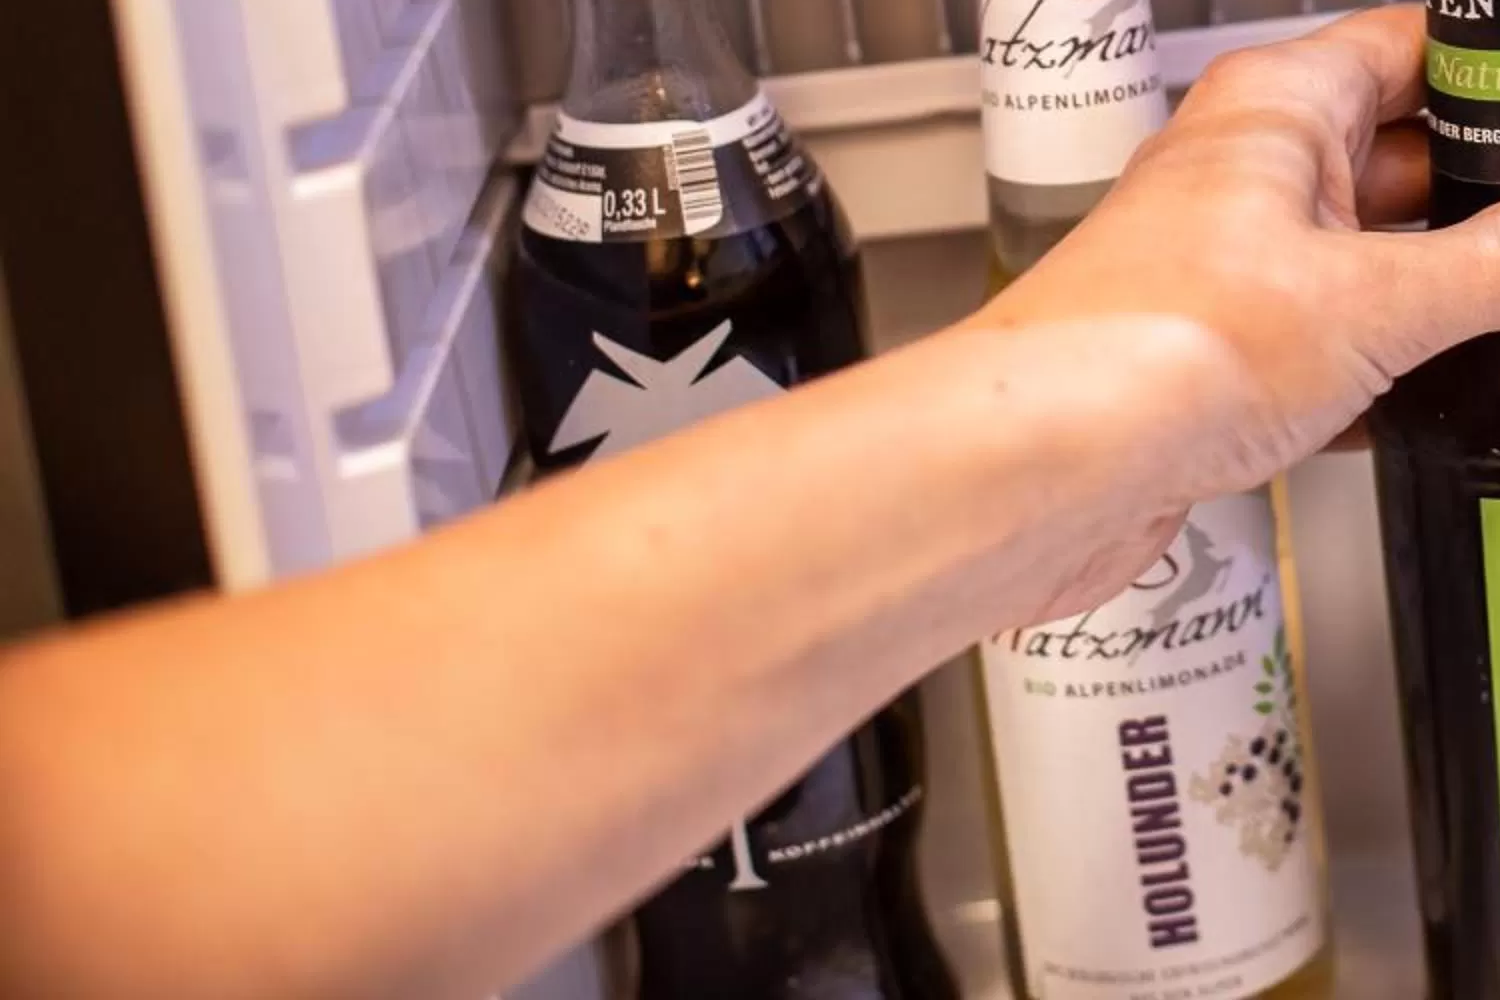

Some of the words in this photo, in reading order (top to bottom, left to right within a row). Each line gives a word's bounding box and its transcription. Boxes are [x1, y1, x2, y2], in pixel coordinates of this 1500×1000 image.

[1004, 73, 1163, 111] ALPENLIMONAD
[603, 188, 647, 220] 0,33
[652, 187, 666, 215] L
[1064, 651, 1248, 698] ALPENLIMONADE
[1119, 714, 1199, 949] HOLUNDER
